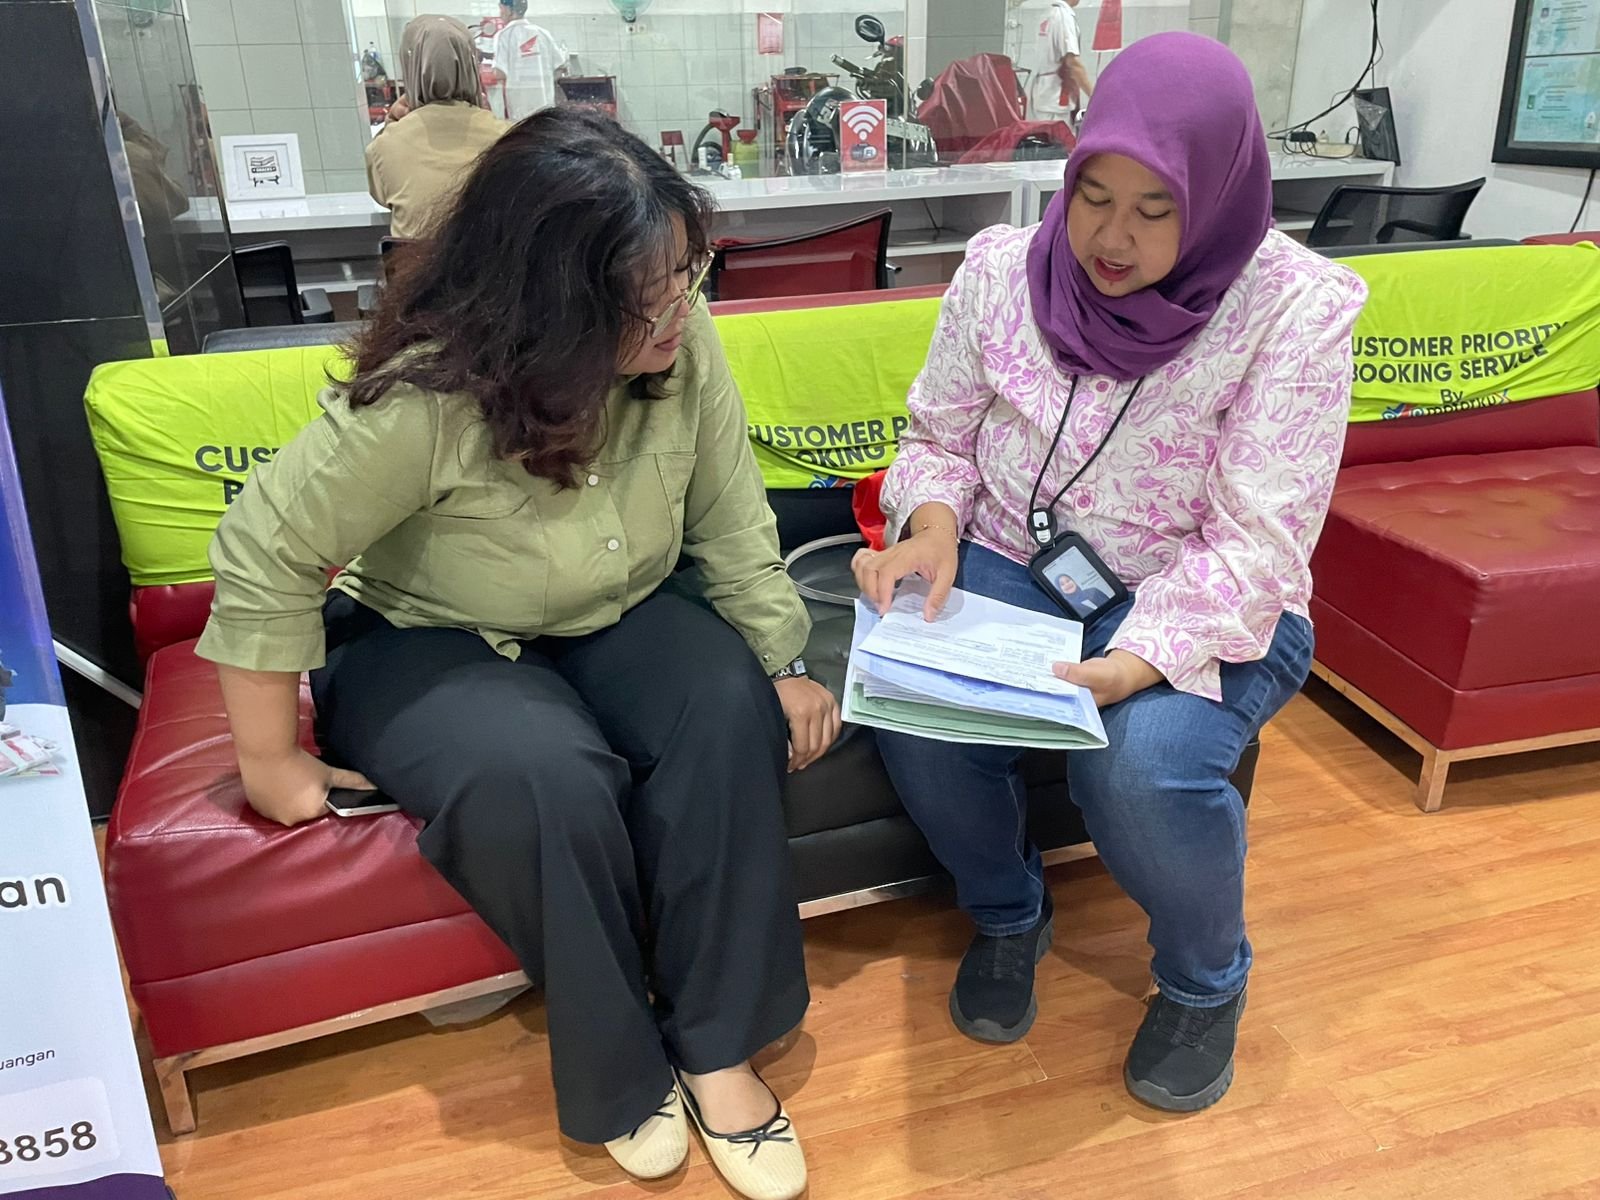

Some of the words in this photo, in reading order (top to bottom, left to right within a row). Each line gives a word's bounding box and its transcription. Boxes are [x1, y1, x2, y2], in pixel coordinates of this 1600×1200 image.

[748, 419, 887, 448] USTOMER
[892, 414, 912, 440] P
[195, 445, 280, 473] CUS
